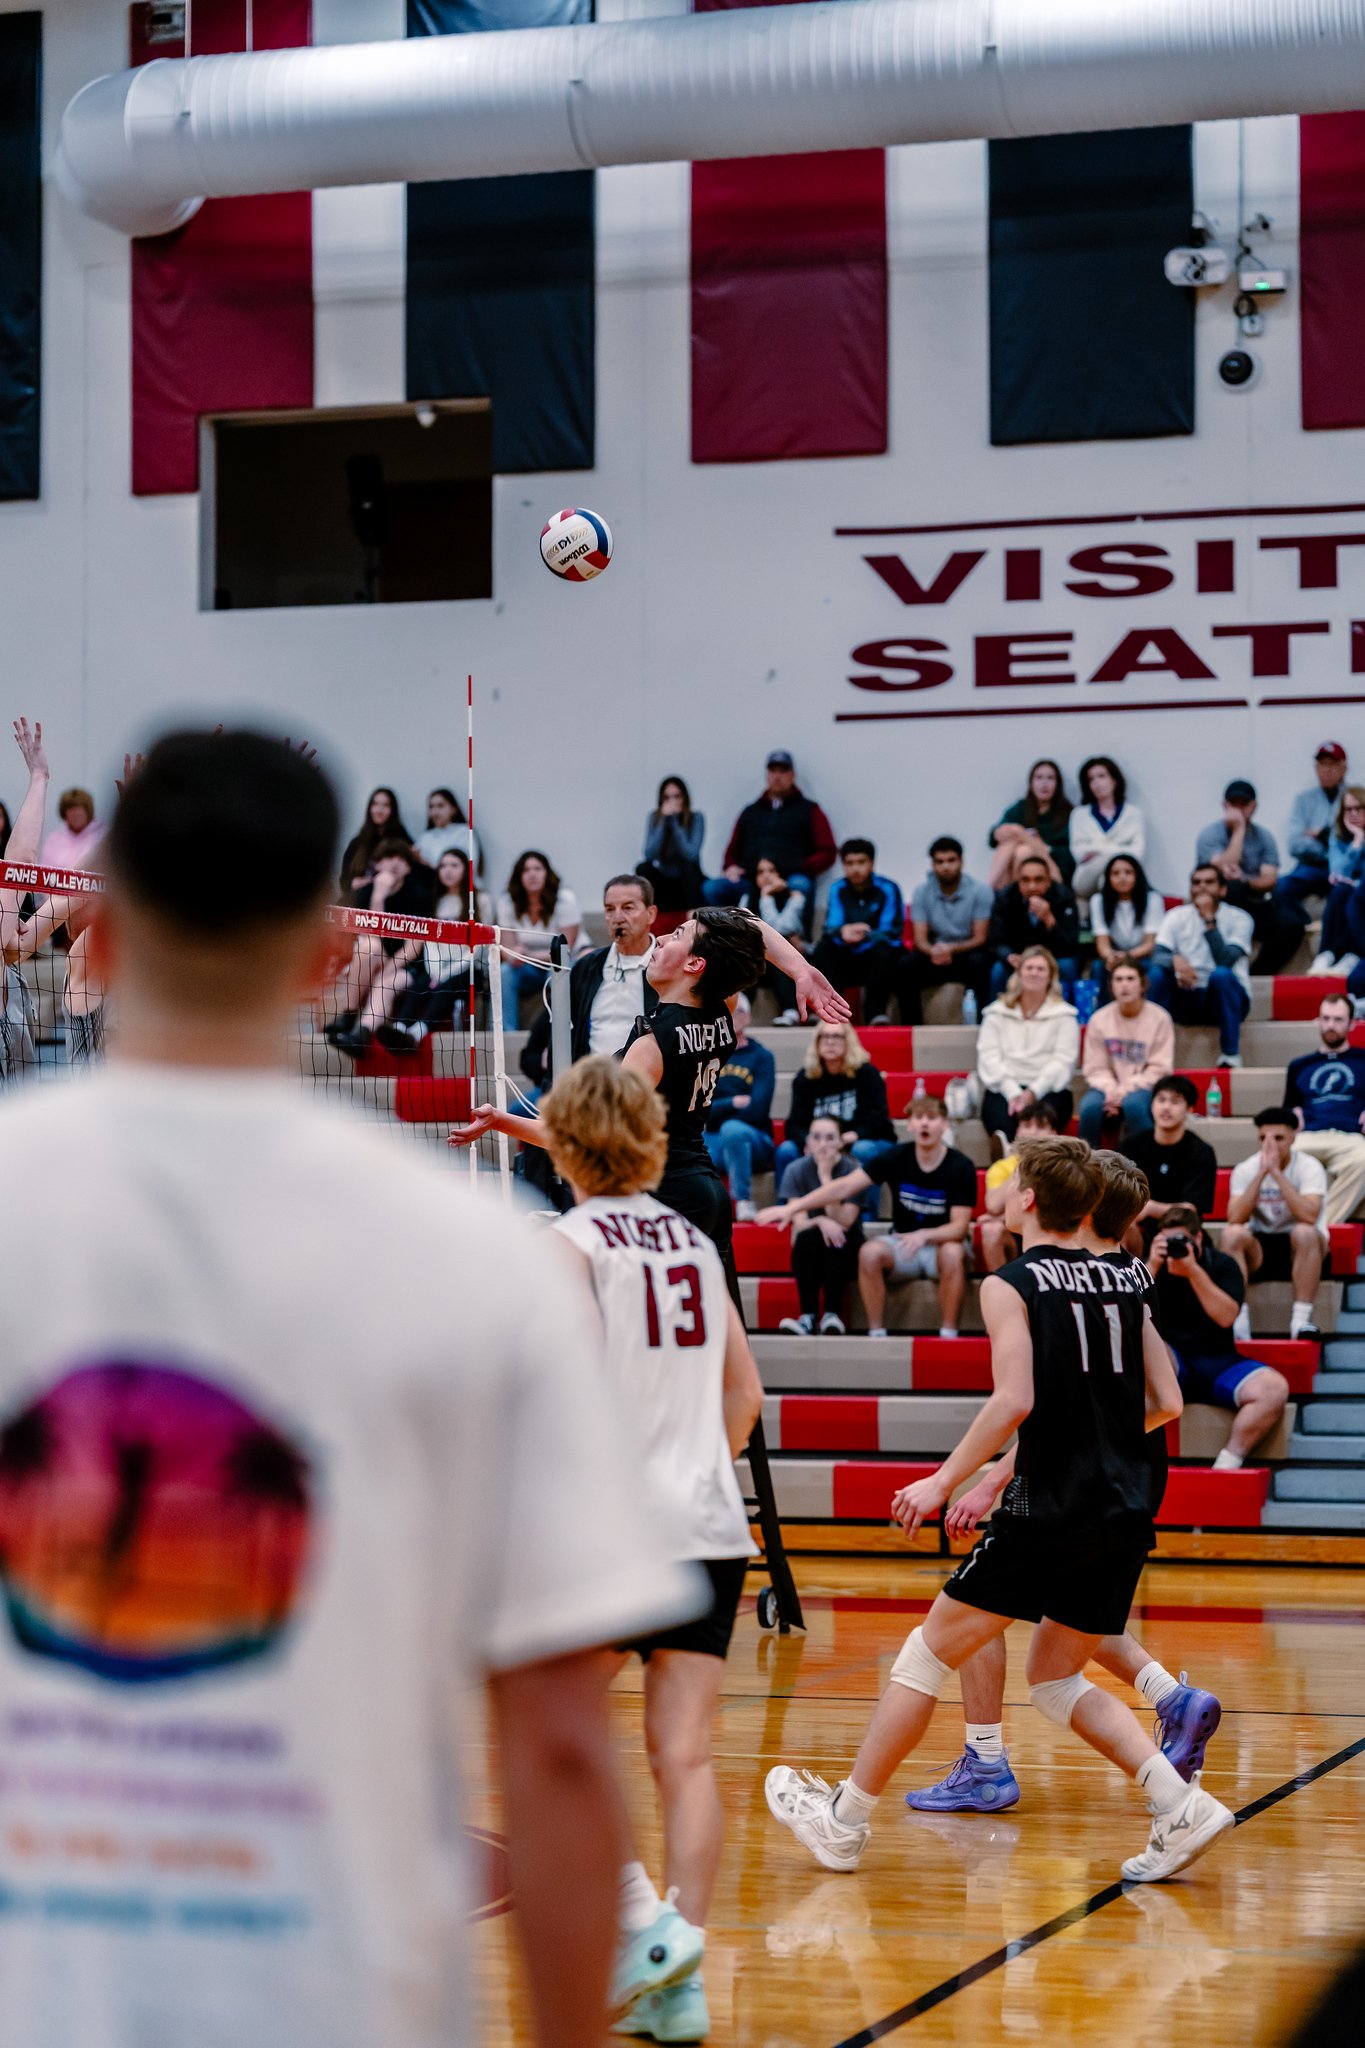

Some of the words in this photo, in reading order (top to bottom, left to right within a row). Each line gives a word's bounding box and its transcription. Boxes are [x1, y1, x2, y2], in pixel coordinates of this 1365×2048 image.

[558, 543, 590, 566] Wilson
[862, 533, 1365, 605] VISIT
[4, 866, 38, 885] PNHS
[675, 1015, 733, 1054] NORH
[1025, 1258, 1135, 1294] NORTH
[642, 1261, 707, 1348] 13
[1070, 1301, 1124, 1374] 11
